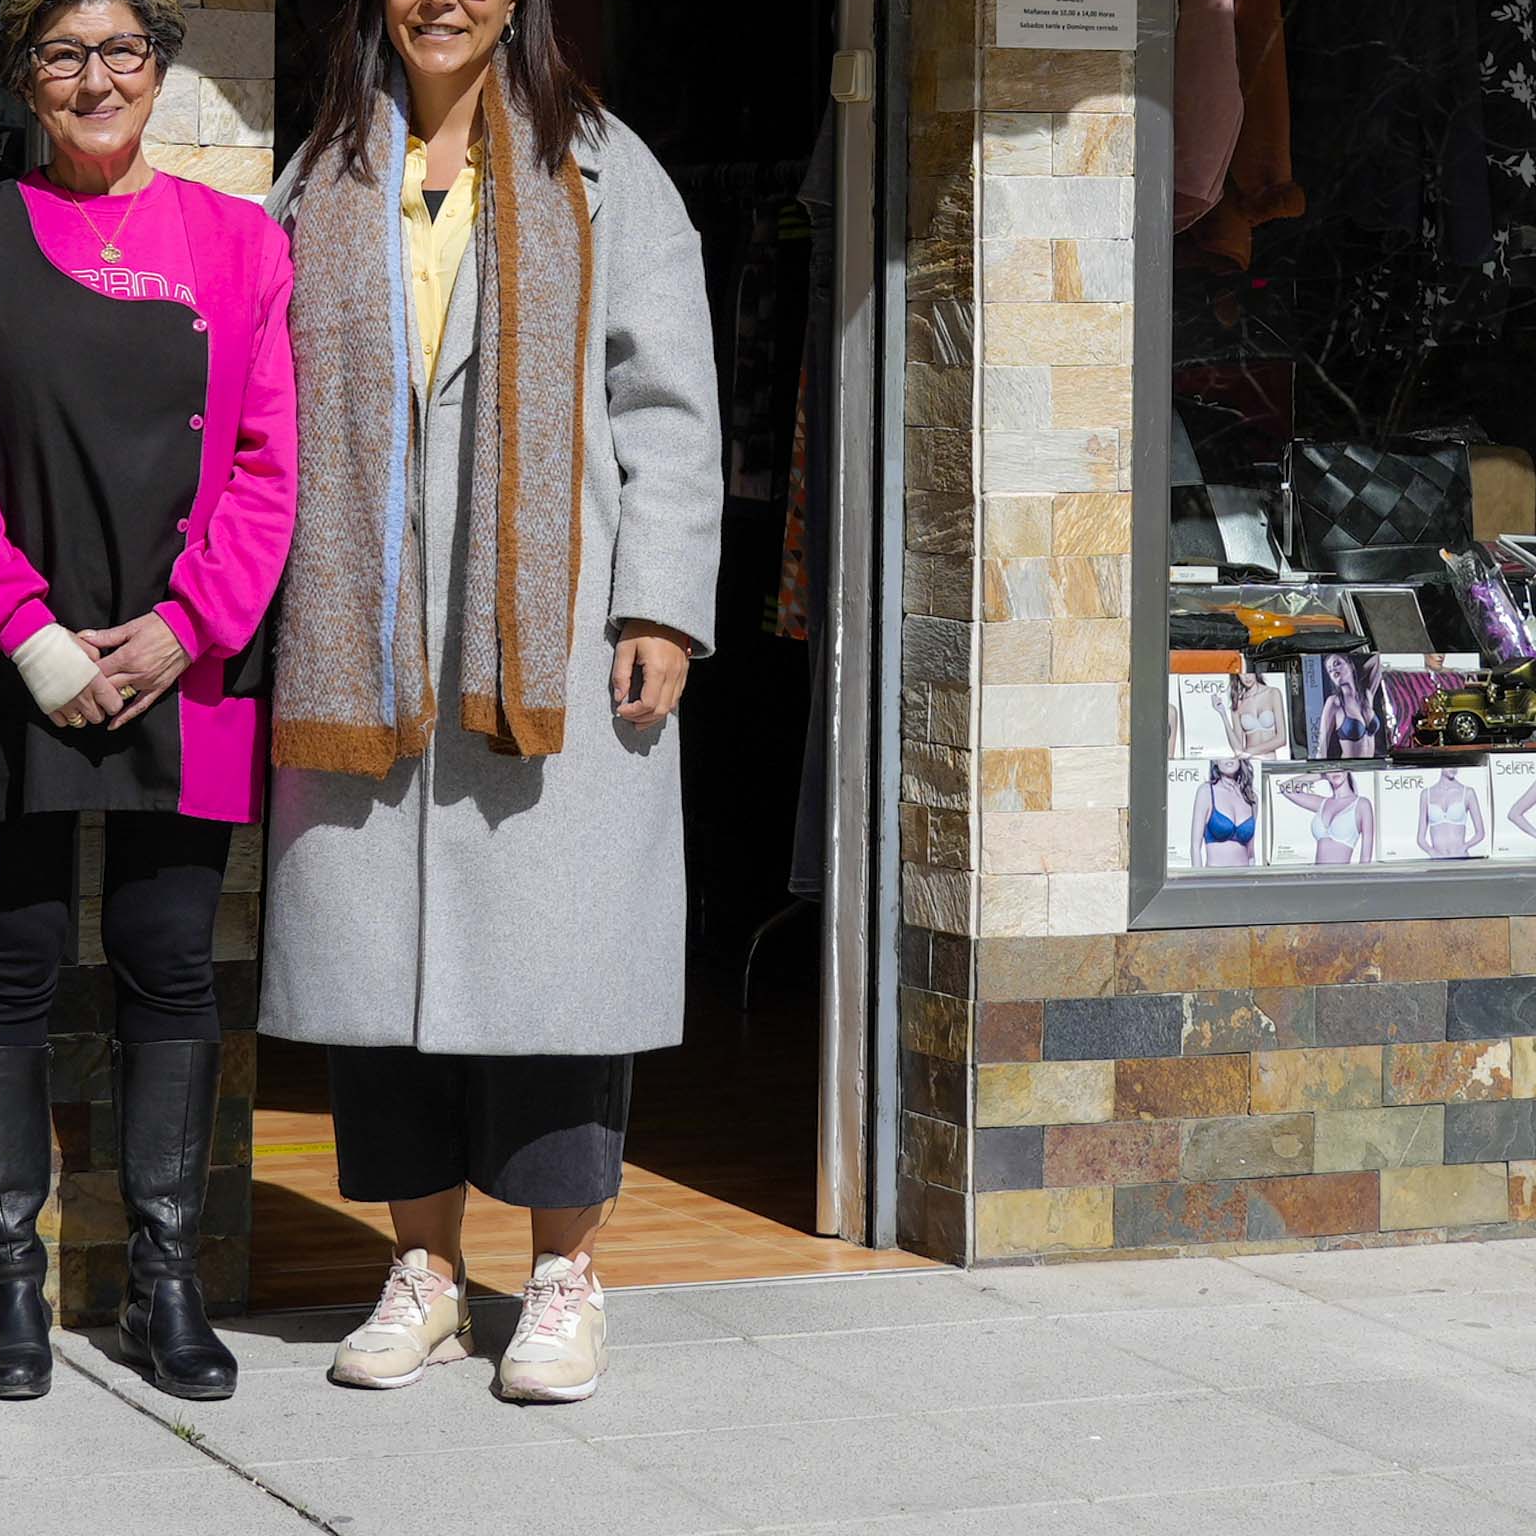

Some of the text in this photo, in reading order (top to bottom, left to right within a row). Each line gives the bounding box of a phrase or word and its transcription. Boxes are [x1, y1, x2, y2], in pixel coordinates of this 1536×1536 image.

[1184, 679, 1226, 694] Selene
[1167, 769, 1200, 782] elene
[1495, 760, 1536, 776] Selene
[1384, 775, 1424, 790] Selene
